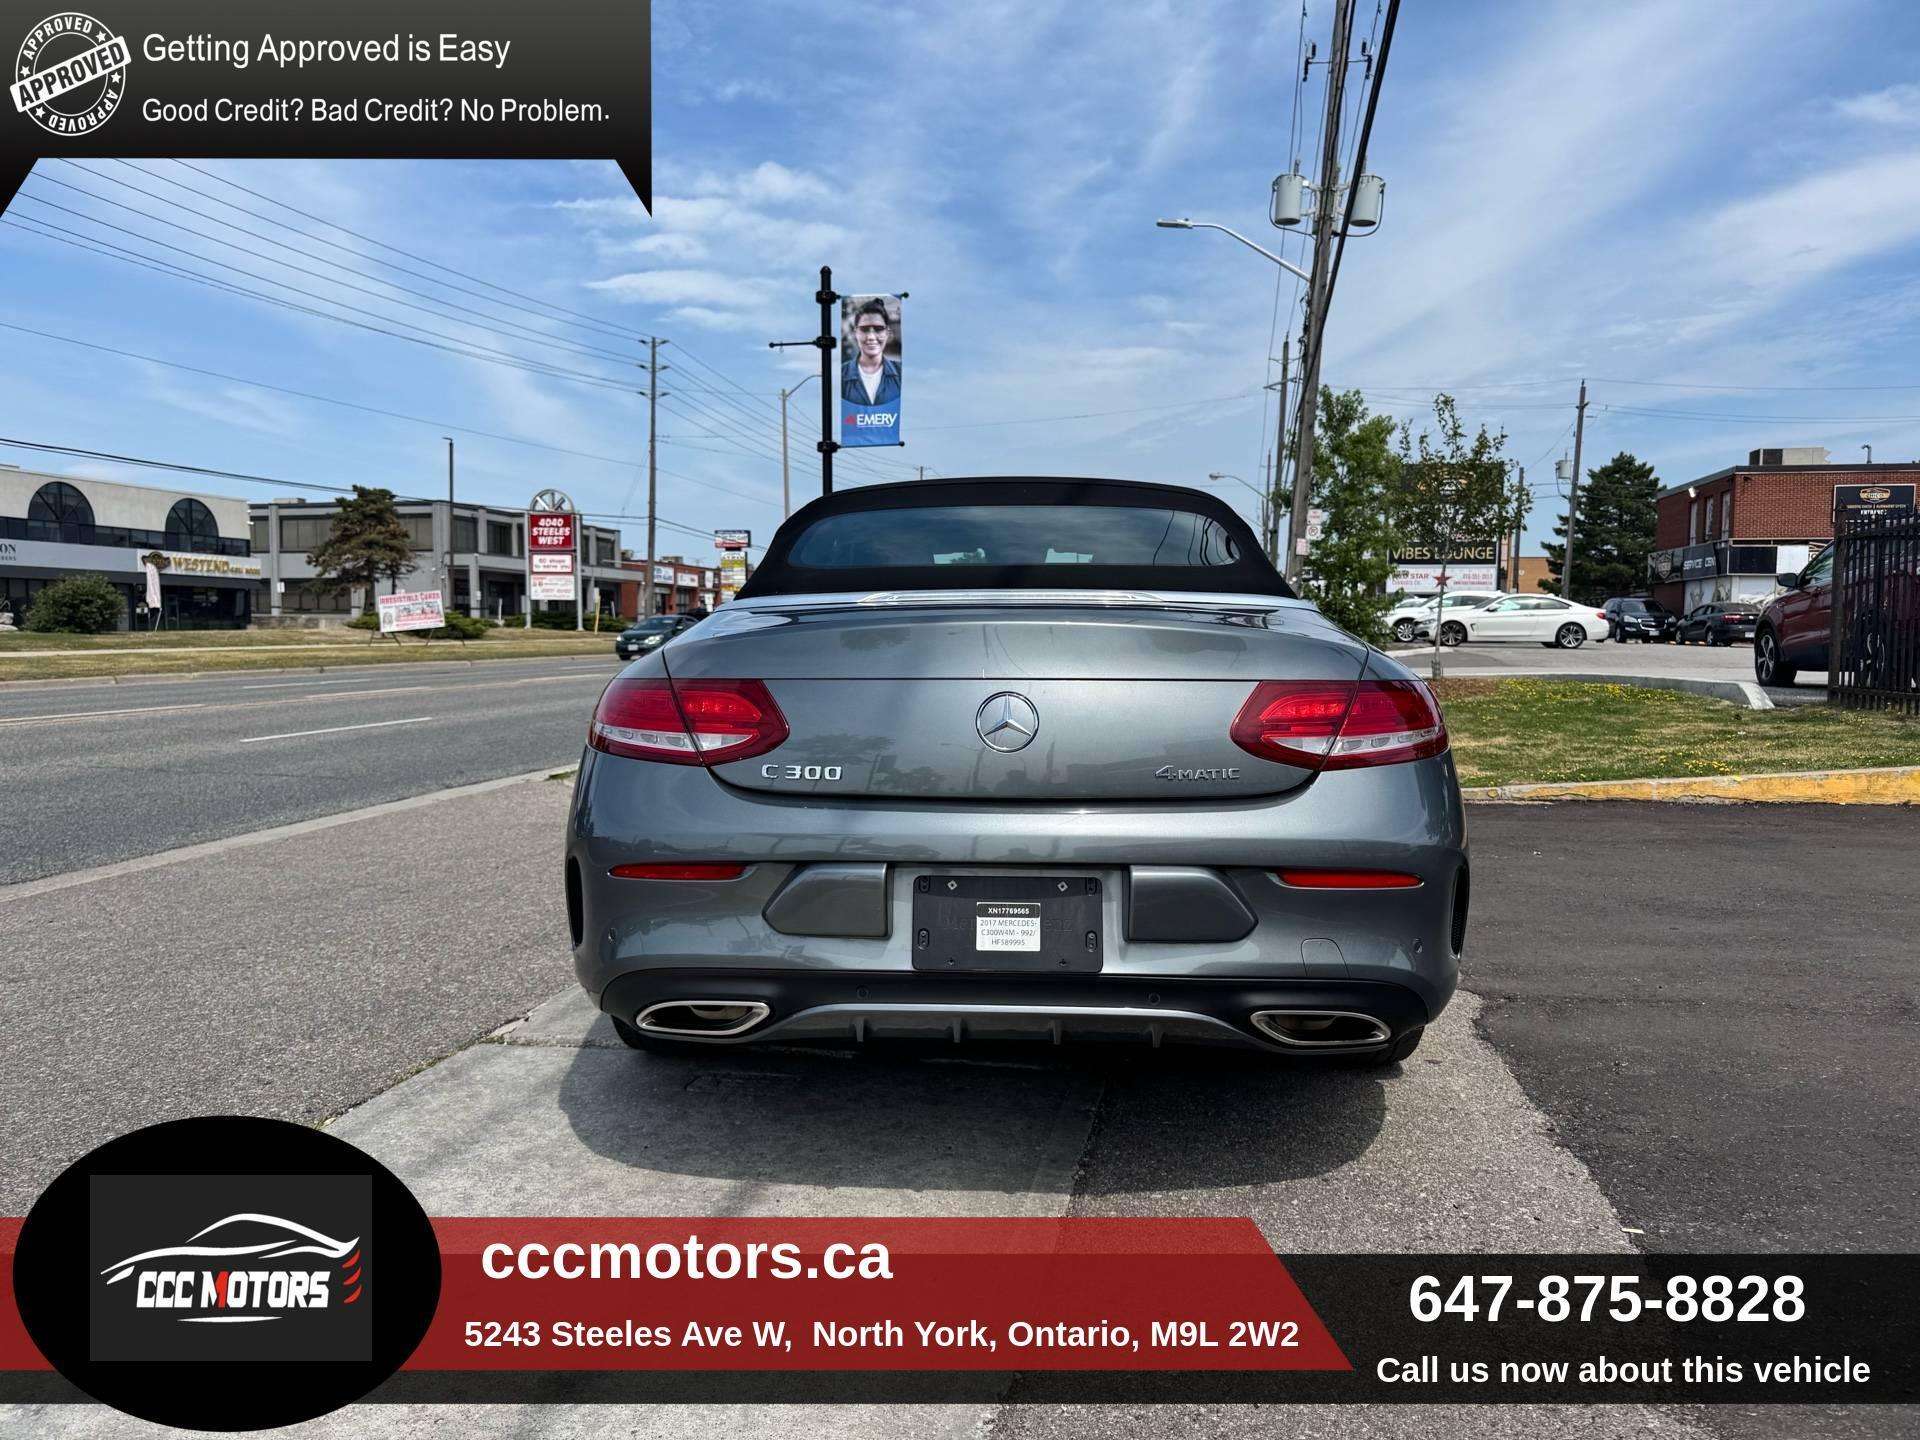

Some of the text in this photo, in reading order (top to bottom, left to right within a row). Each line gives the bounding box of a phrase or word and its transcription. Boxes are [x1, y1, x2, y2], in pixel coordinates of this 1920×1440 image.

[857, 413, 898, 428] EMERY
[538, 518, 564, 527] 4040
[532, 527, 571, 536] STEELES
[538, 536, 565, 545] WEST
[1392, 546, 1430, 560] VIBES
[172, 557, 230, 574] WESTEND
[761, 764, 842, 780] C 300
[988, 907, 1030, 915] XN17769565
[980, 919, 997, 927] 2017
